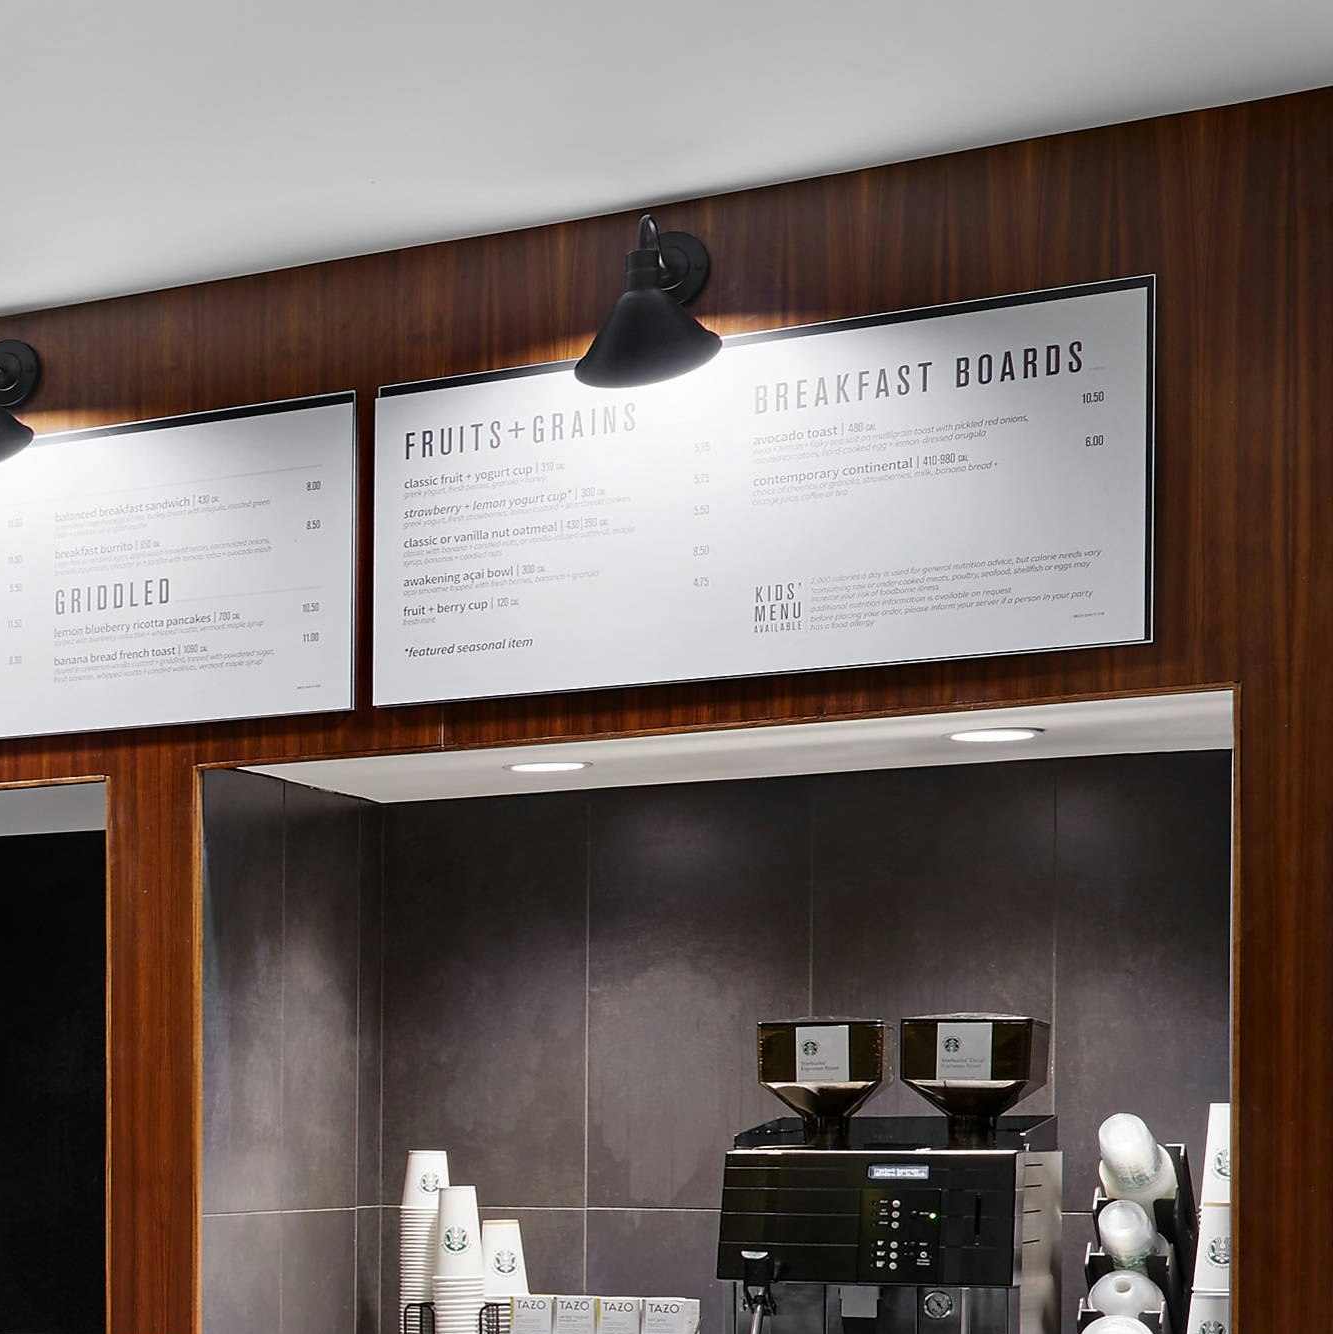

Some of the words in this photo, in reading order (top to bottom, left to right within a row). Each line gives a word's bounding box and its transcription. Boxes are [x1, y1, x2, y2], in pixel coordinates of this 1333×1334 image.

[754, 361, 932, 414] BREAKFAST
[956, 340, 1083, 388] BOARDS
[1081, 390, 1104, 404] 10.50
[404, 402, 636, 460] FRUITS+GRAINS
[935, 422, 952, 432] with
[954, 418, 983, 431] pickled
[984, 416, 998, 426] red
[752, 429, 804, 445] avocado
[806, 425, 837, 439] toast
[1085, 434, 1104, 447] 6.00
[752, 467, 839, 489] contemporary
[842, 458, 912, 476] continental
[922, 452, 955, 466] 410-980
[968, 461, 992, 471] bread
[404, 474, 438, 489] classic
[440, 471, 463, 485] fruit
[474, 465, 510, 483] yogurt
[512, 465, 532, 478] cup
[54, 507, 96, 522] balanced
[98, 501, 142, 517] breakfast
[145, 495, 190, 511] sandwich
[403, 501, 462, 521] strawberry
[472, 496, 506, 510] lemon
[507, 491, 544, 509] yogurt
[403, 534, 437, 548] classic
[439, 535, 451, 544] or
[453, 528, 488, 542] vanilla
[491, 526, 509, 538] nut
[512, 520, 557, 536] oatmeal
[54, 545, 98, 559] breakfast
[100, 541, 133, 554] burrito
[1030, 553, 1056, 562] calorie
[1058, 550, 1082, 559] needs
[1084, 550, 1101, 559] vary
[403, 571, 461, 589] awakening
[462, 569, 485, 583] açai
[487, 565, 513, 578] bowl
[55, 577, 169, 615] GRIDDLED
[754, 581, 801, 603] KIDS'
[1013, 595, 1041, 605] person
[1052, 593, 1069, 602] your
[1071, 590, 1093, 600] party
[402, 604, 426, 616] fruit
[436, 600, 465, 615] berry
[467, 600, 488, 612] cup
[754, 601, 801, 622] MENU
[53, 626, 83, 638] lemon
[85, 621, 130, 636] blueberry
[132, 617, 164, 630] ricotta
[166, 613, 211, 628] pancakes
[753, 620, 802, 634] AVAILABLE
[456, 637, 506, 653] seasonal
[508, 635, 533, 648] item
[53, 653, 88, 666] banana
[89, 651, 117, 662] bread
[119, 647, 149, 660] french
[151, 645, 175, 657] toast
[517, 1299, 546, 1311] TAZO
[560, 1300, 590, 1312] TAZO
[603, 1302, 634, 1314] TAZO
[648, 1303, 680, 1315] TAZO
